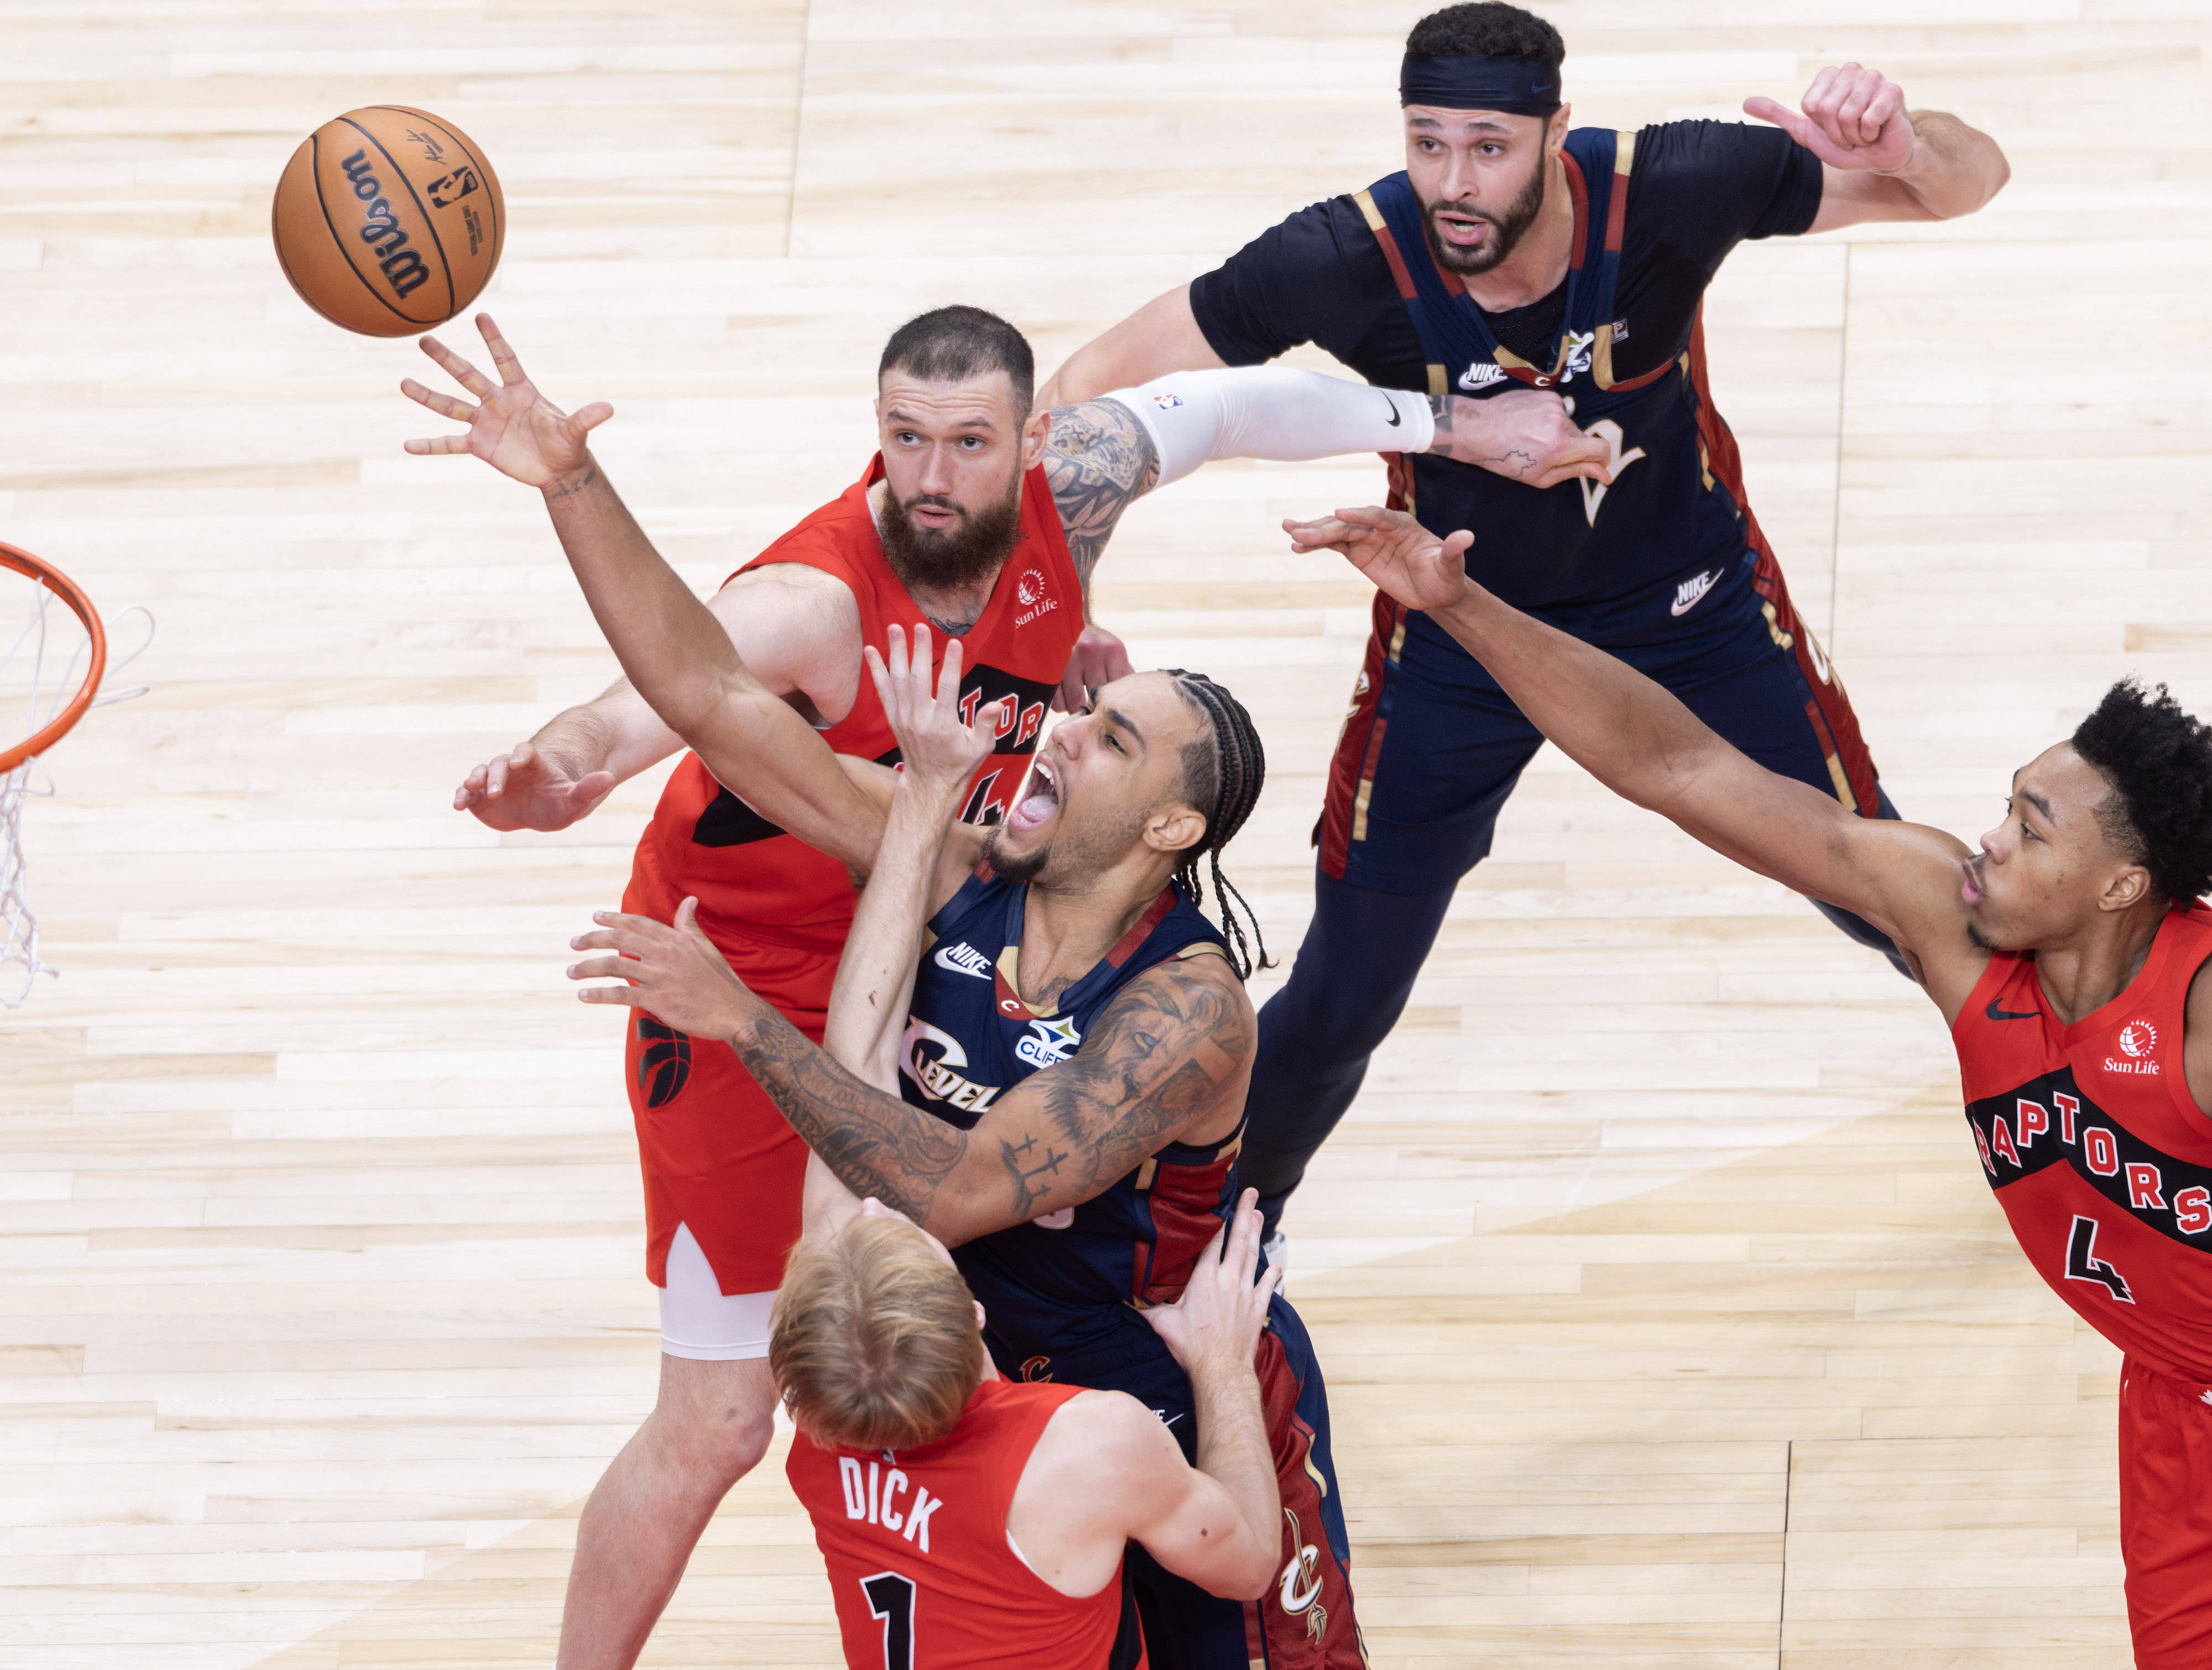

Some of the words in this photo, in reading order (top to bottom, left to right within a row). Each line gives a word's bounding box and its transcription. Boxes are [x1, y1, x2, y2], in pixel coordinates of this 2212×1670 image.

[341, 148, 430, 300] Wilson
[1467, 363, 1509, 382] NIKE
[1535, 377, 1551, 386] C
[1678, 570, 1713, 605] NIKE
[1015, 616, 1034, 629] Sun
[1035, 599, 1057, 616] Life
[948, 941, 992, 974] NIKE
[1001, 1000, 1019, 1012] C
[2104, 1058, 2132, 1073] Sun
[2135, 1060, 2159, 1074] Life
[1972, 1091, 2212, 1235] RAPTORS
[2064, 1214, 2135, 1304] 4
[839, 1456, 943, 1553] DICK
[859, 1570, 916, 1670] 1
